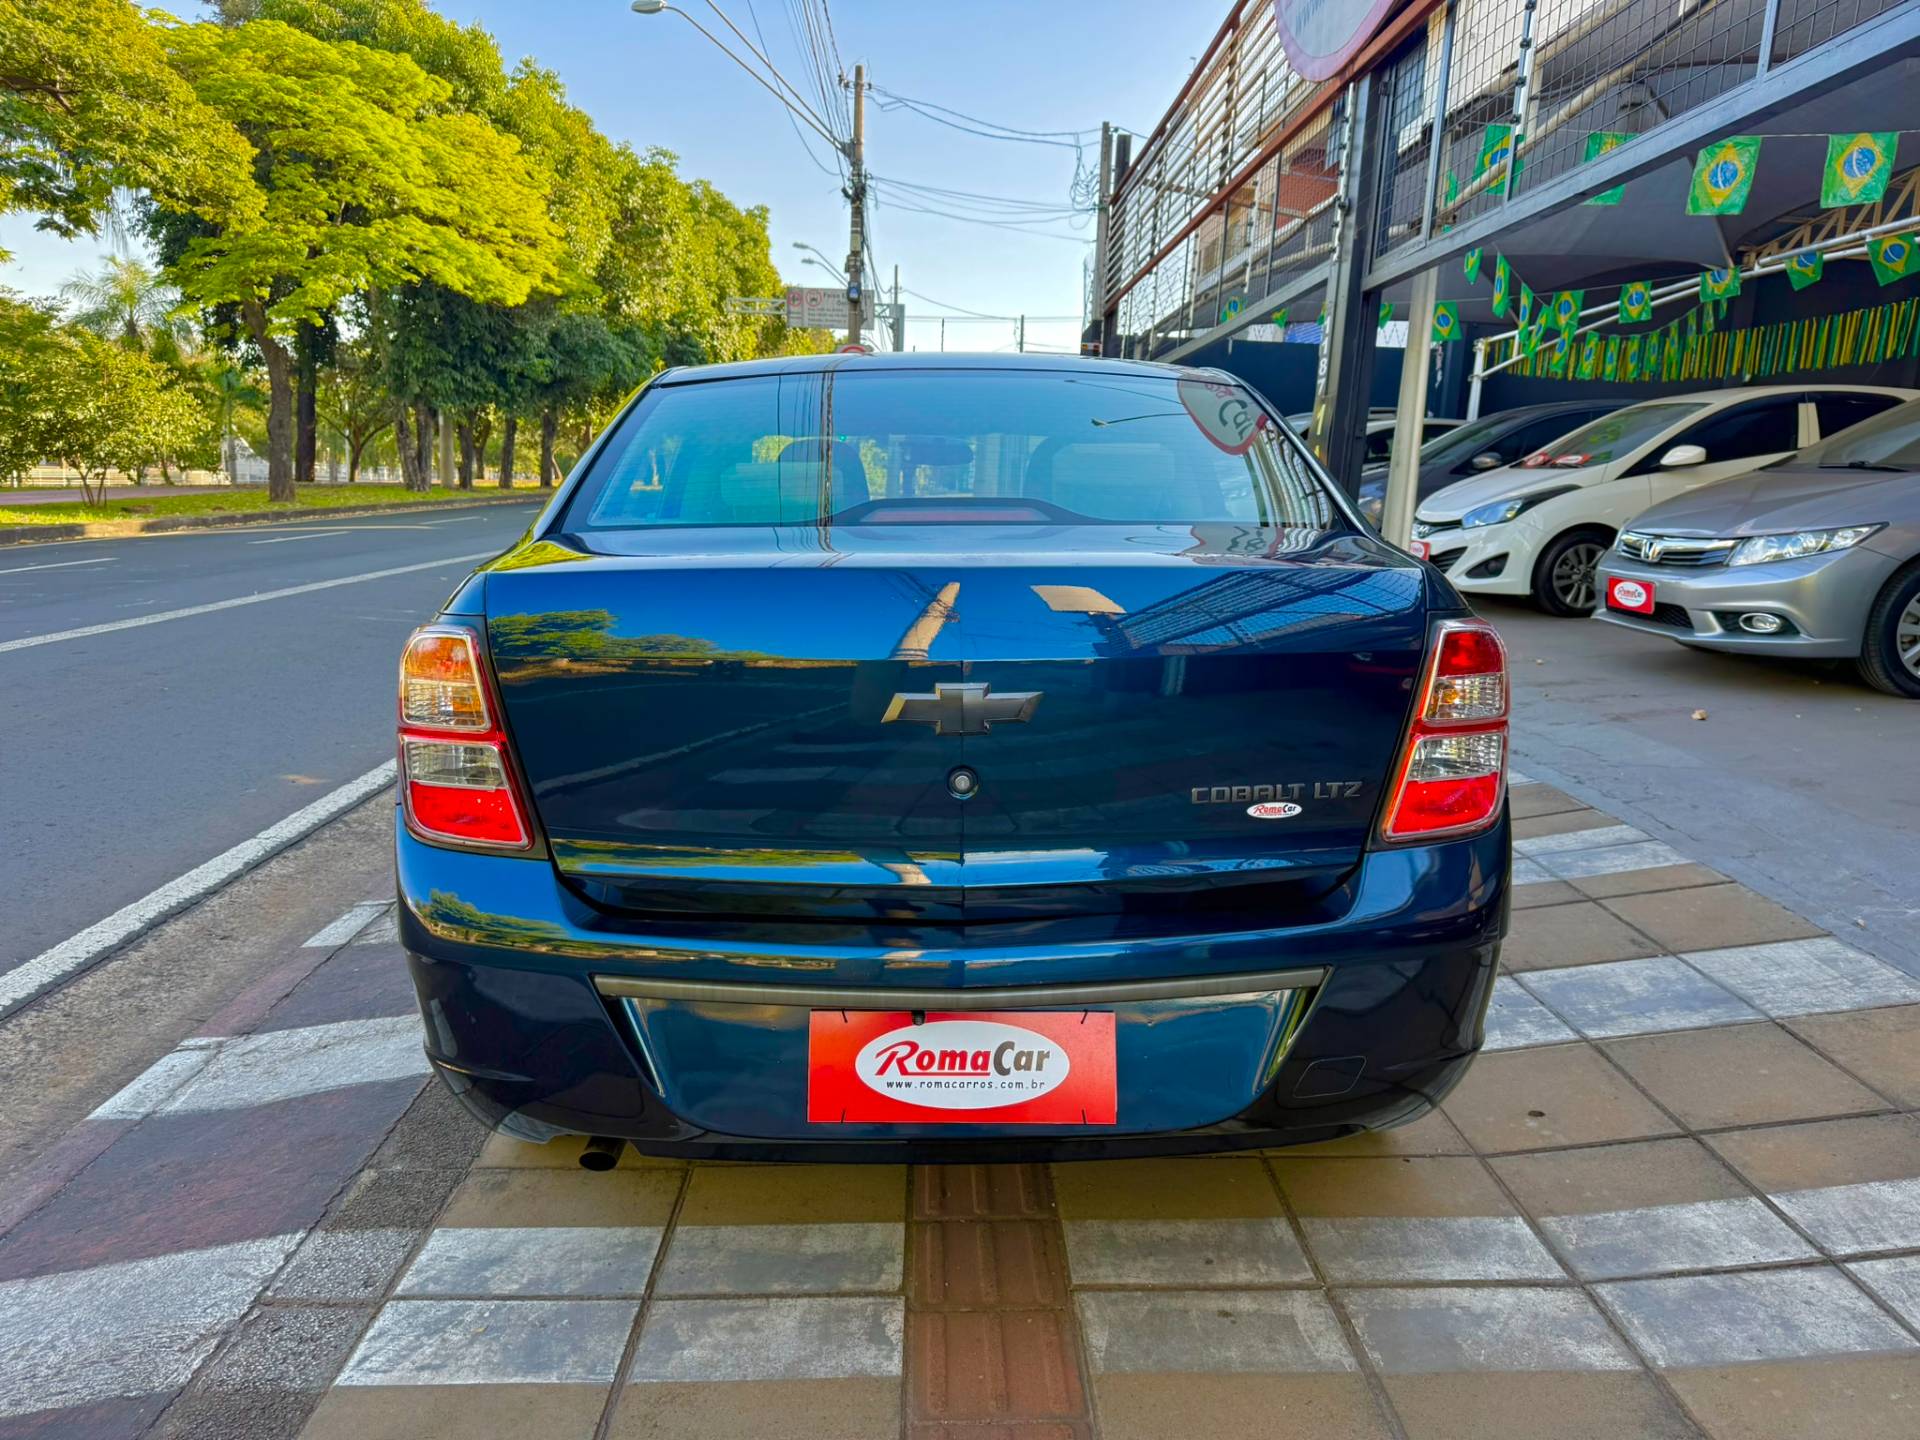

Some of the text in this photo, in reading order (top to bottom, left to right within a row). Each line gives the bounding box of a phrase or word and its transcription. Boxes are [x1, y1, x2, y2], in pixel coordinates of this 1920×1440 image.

[1191, 781, 1363, 804] COBALT LTZ
[1253, 804, 1296, 814] RomaCar
[875, 1041, 1051, 1076] RomaCar
[886, 1079, 1046, 1089] www.romacarros.com.br
